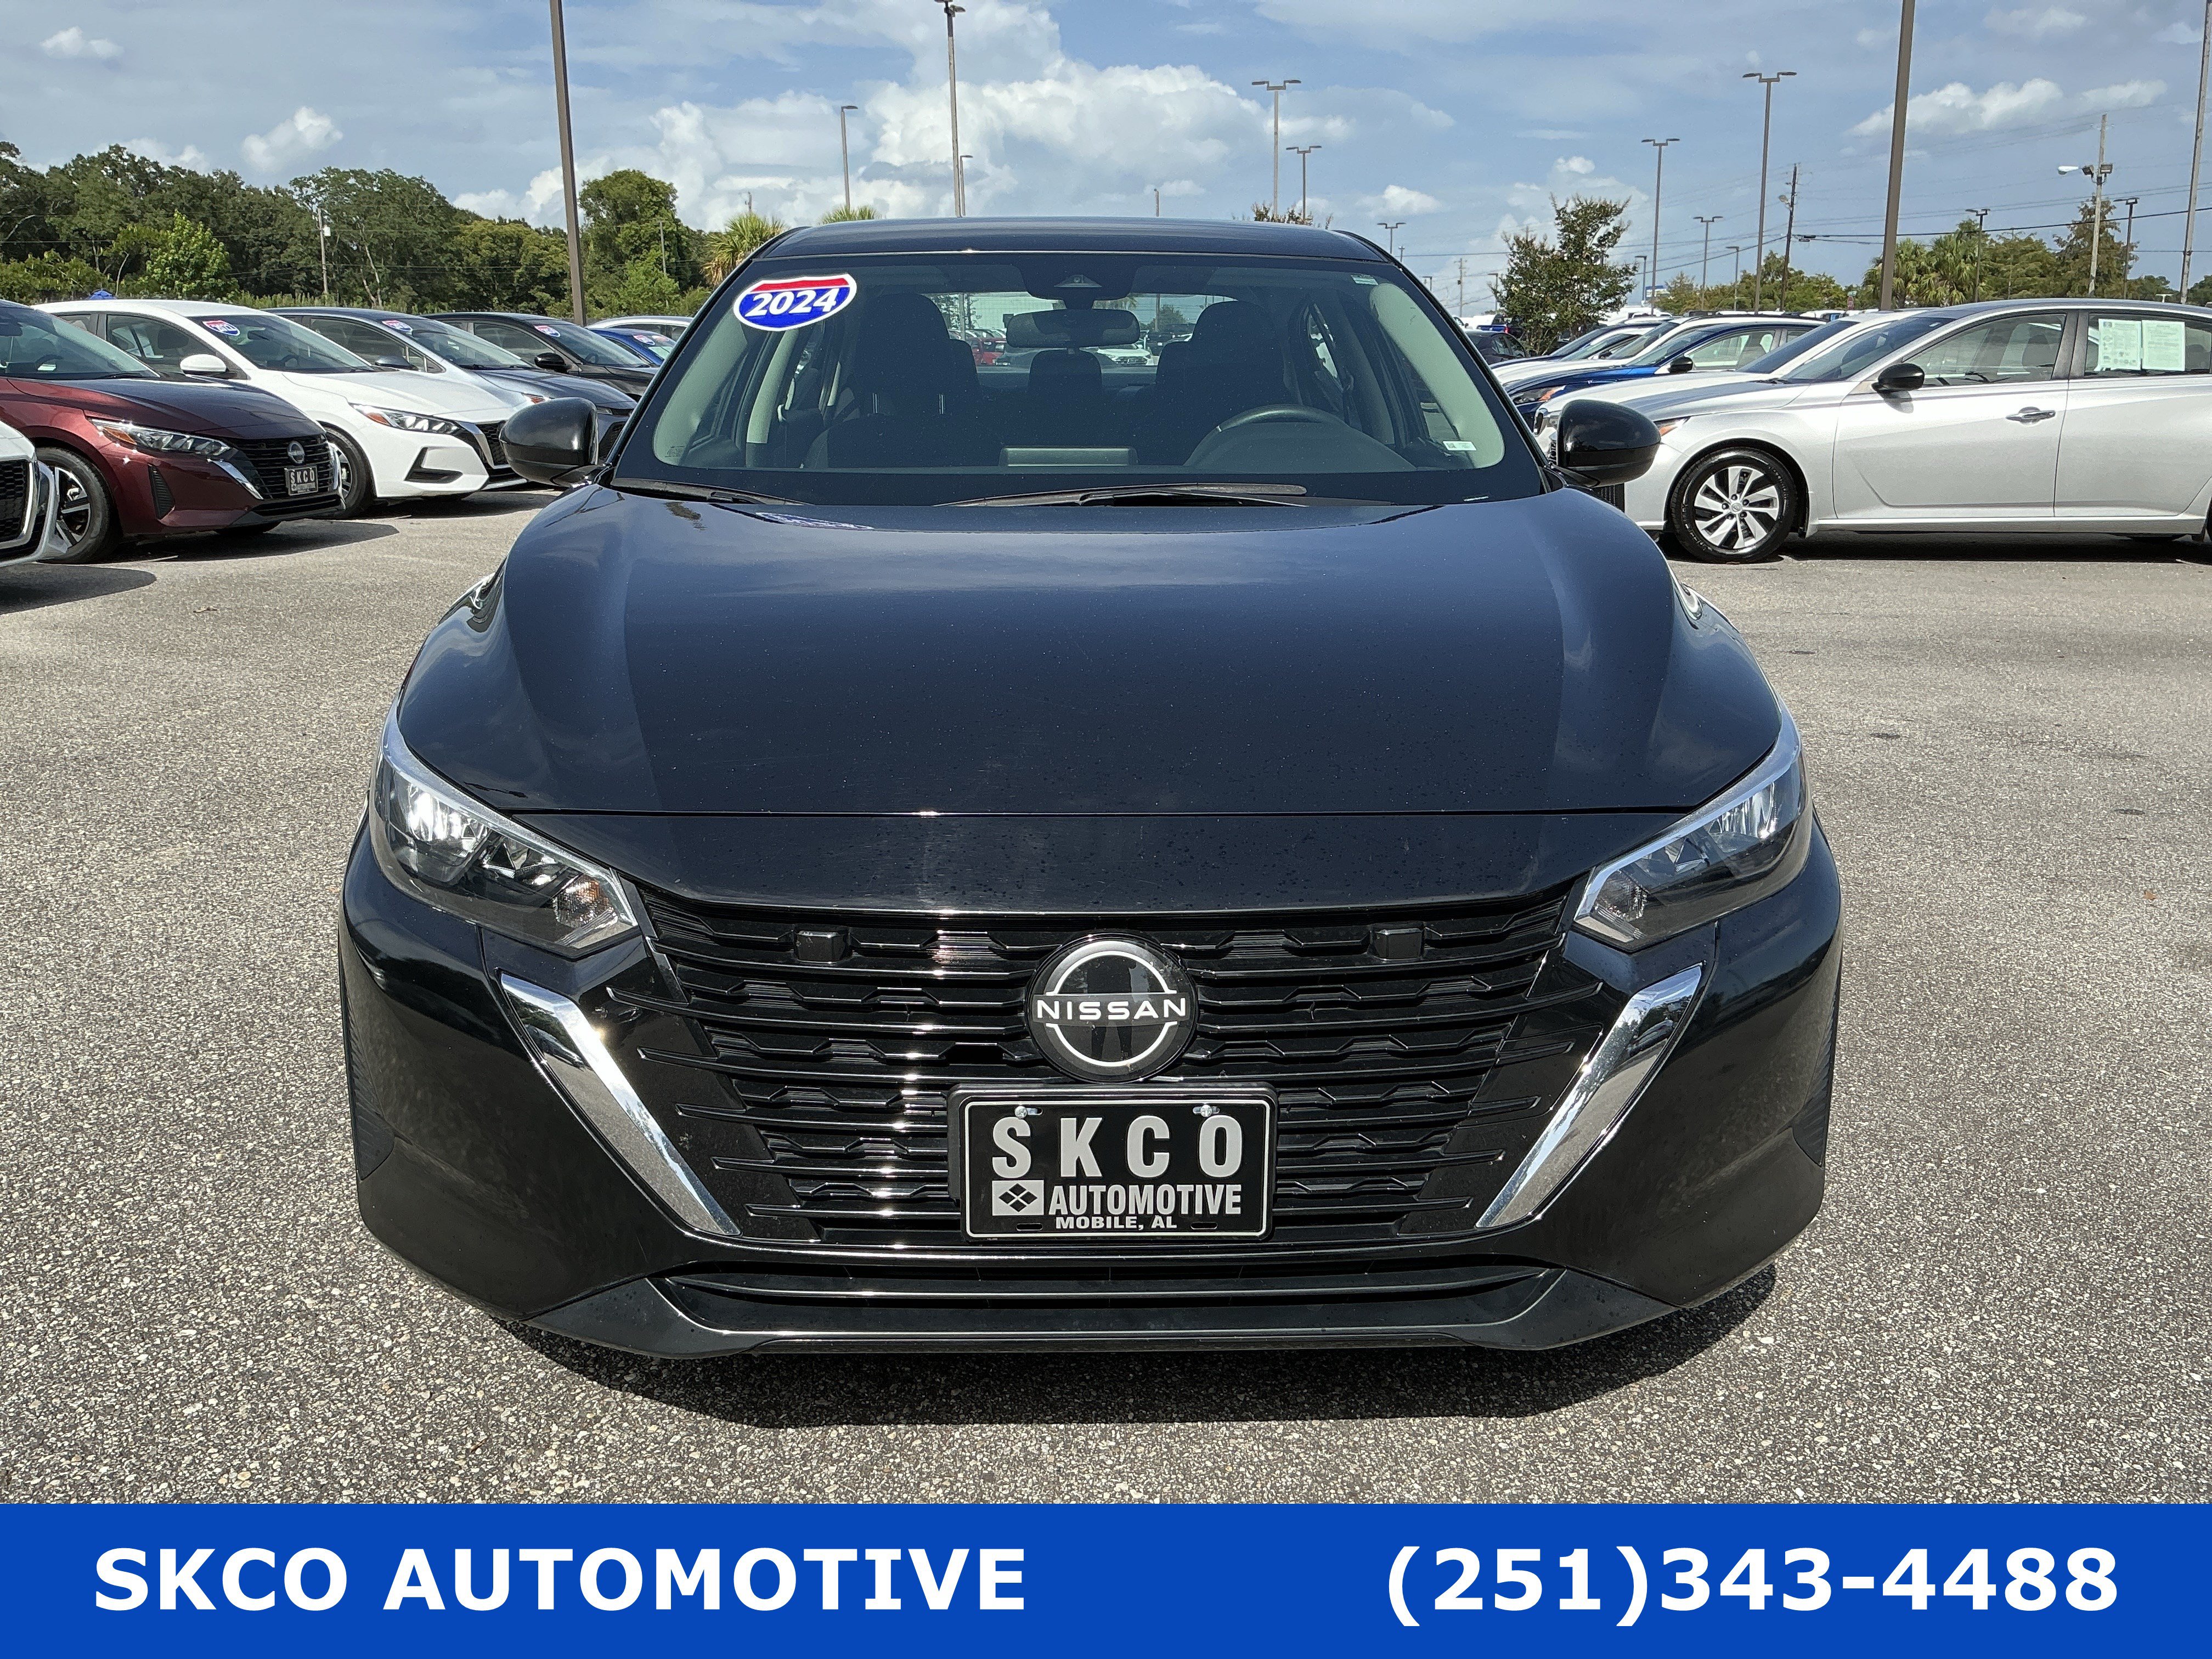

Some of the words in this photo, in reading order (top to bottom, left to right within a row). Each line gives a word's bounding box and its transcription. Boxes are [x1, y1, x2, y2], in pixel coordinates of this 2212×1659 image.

[744, 288, 840, 317] 2024
[290, 470, 315, 484] SKCO
[1037, 997, 1186, 1020] NISSAN
[992, 1115, 1242, 1178] SKCO
[1048, 1184, 1242, 1216] AUTOMOTIVE
[1056, 1216, 1144, 1231] MOBILE,
[1151, 1216, 1177, 1229] AL
